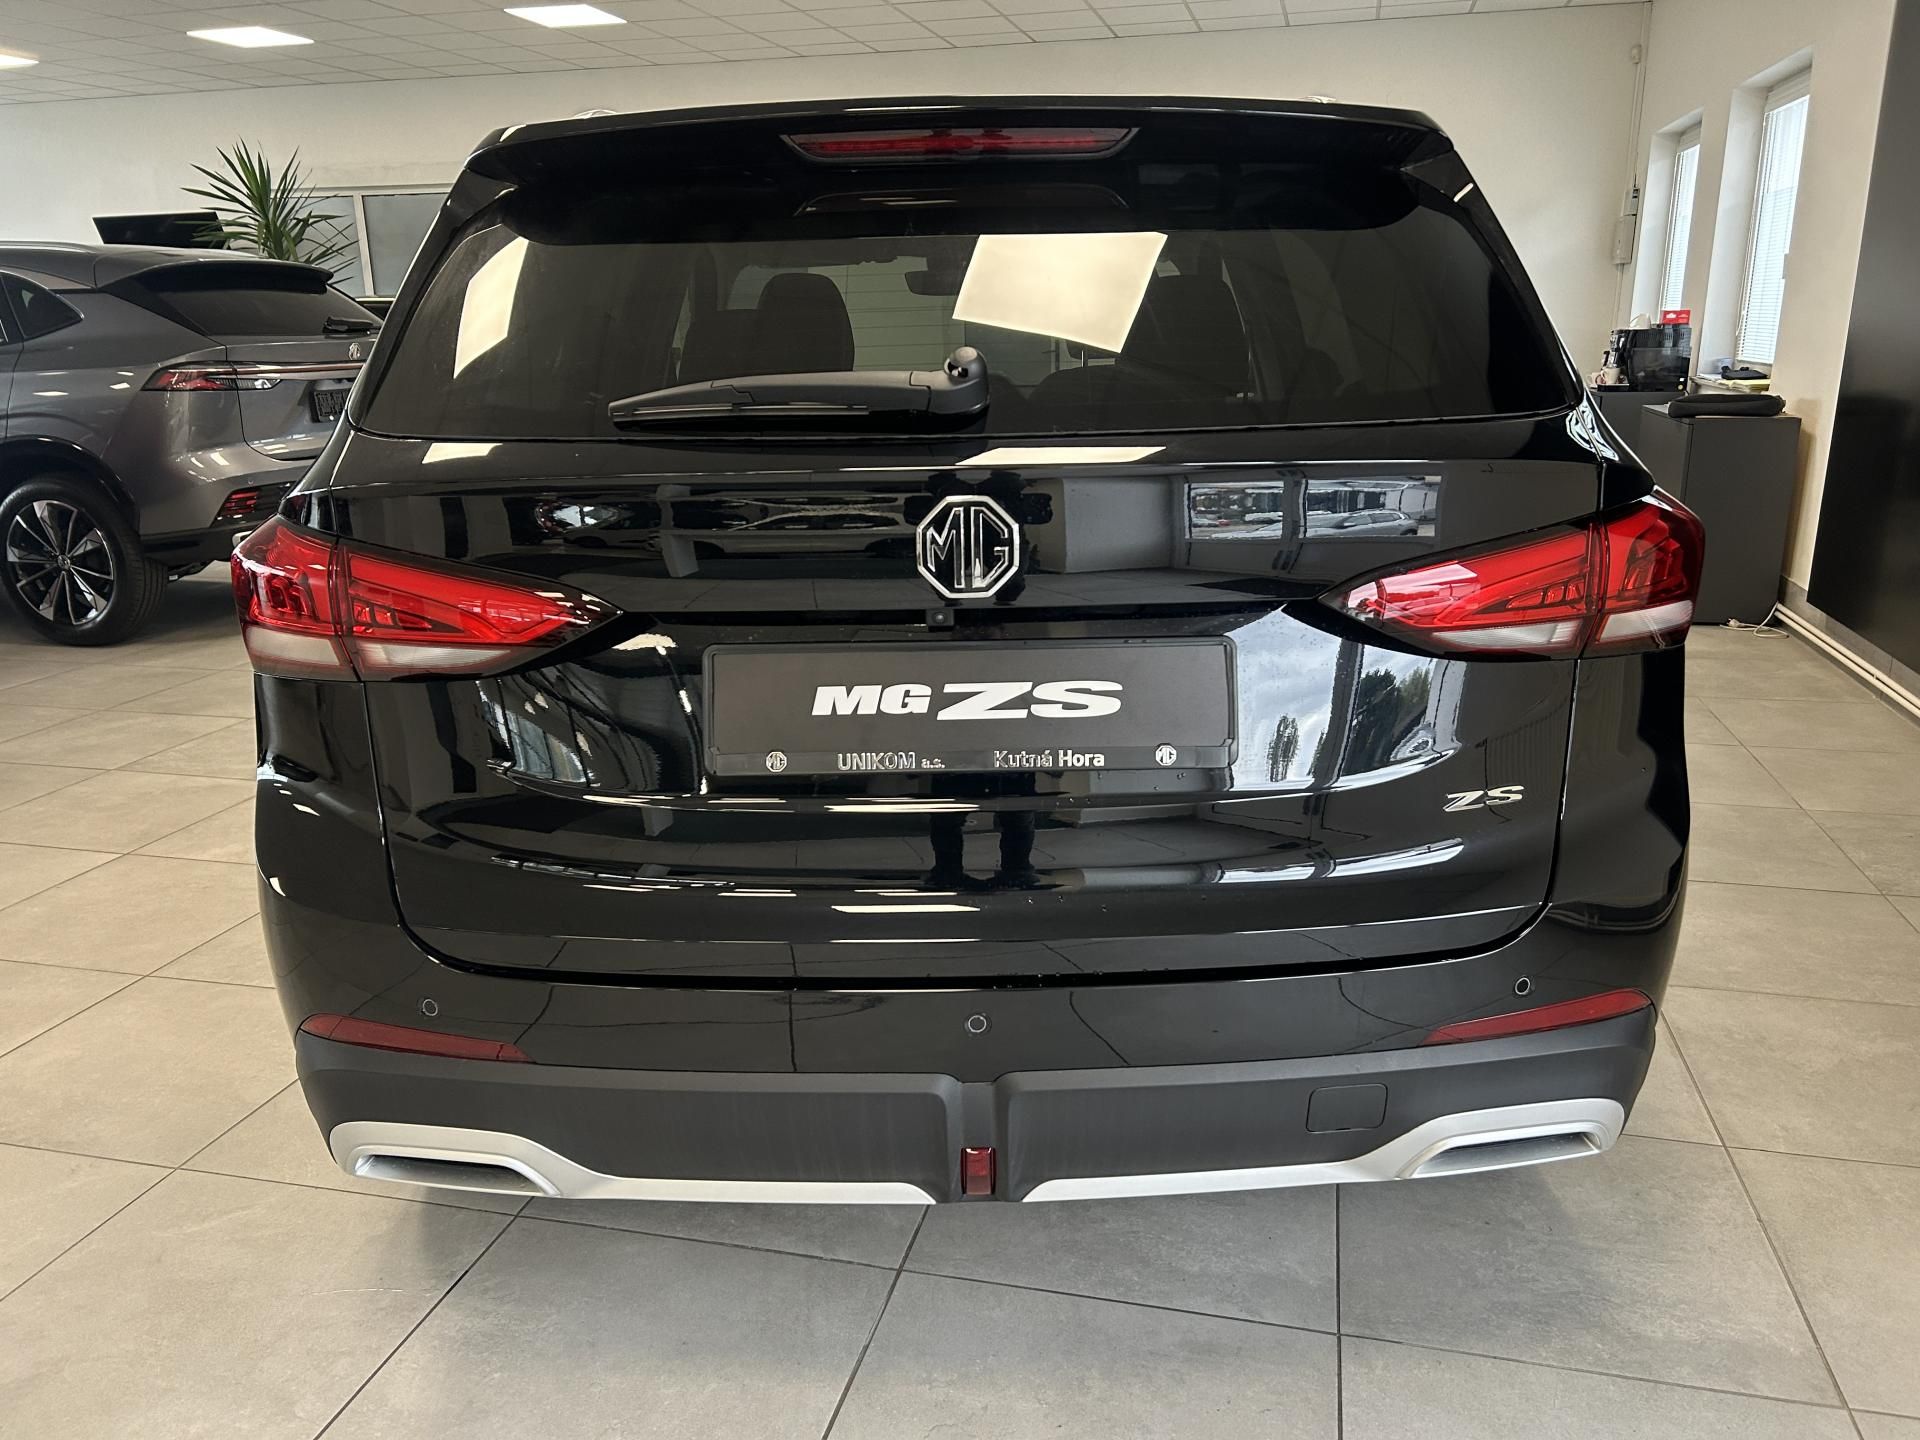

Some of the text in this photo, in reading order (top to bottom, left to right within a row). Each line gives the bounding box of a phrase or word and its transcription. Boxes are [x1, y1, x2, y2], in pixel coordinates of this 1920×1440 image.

[924, 504, 1011, 590] MG
[811, 680, 1123, 721] MG ZS
[766, 752, 787, 772] MG
[837, 752, 916, 771] UNIKOM
[993, 749, 1105, 768] Kutná Hora
[1155, 745, 1177, 766] MG
[1443, 785, 1524, 812] ZS
